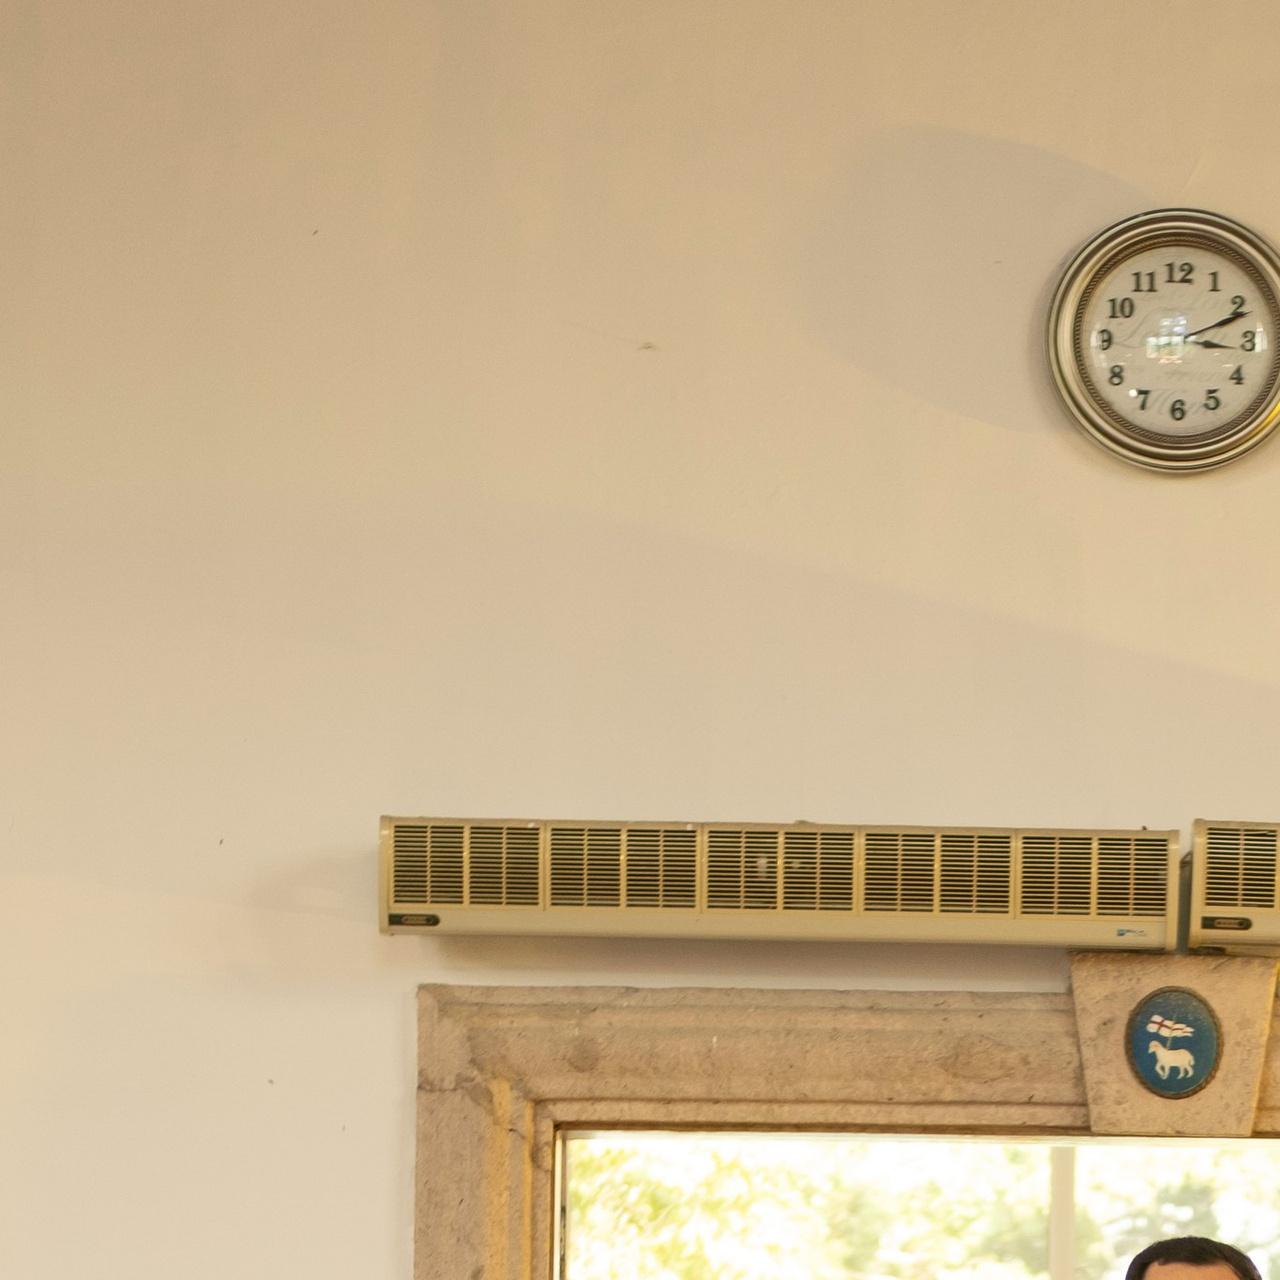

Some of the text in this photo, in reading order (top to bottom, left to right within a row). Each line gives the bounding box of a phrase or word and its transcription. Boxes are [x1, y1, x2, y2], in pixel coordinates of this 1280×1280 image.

[1131, 270, 1158, 293] 11
[1165, 261, 1194, 284] 12
[1208, 270, 1221, 292] 1
[1108, 296, 1134, 319] 10
[1231, 295, 1246, 316] 2
[1099, 328, 1113, 351] 9
[1240, 330, 1256, 352] 3
[1108, 364, 1124, 386] 8
[1229, 364, 1244, 385] 4
[1136, 388, 1151, 411] 7
[1170, 399, 1186, 421] 6
[1204, 388, 1221, 411] 5
